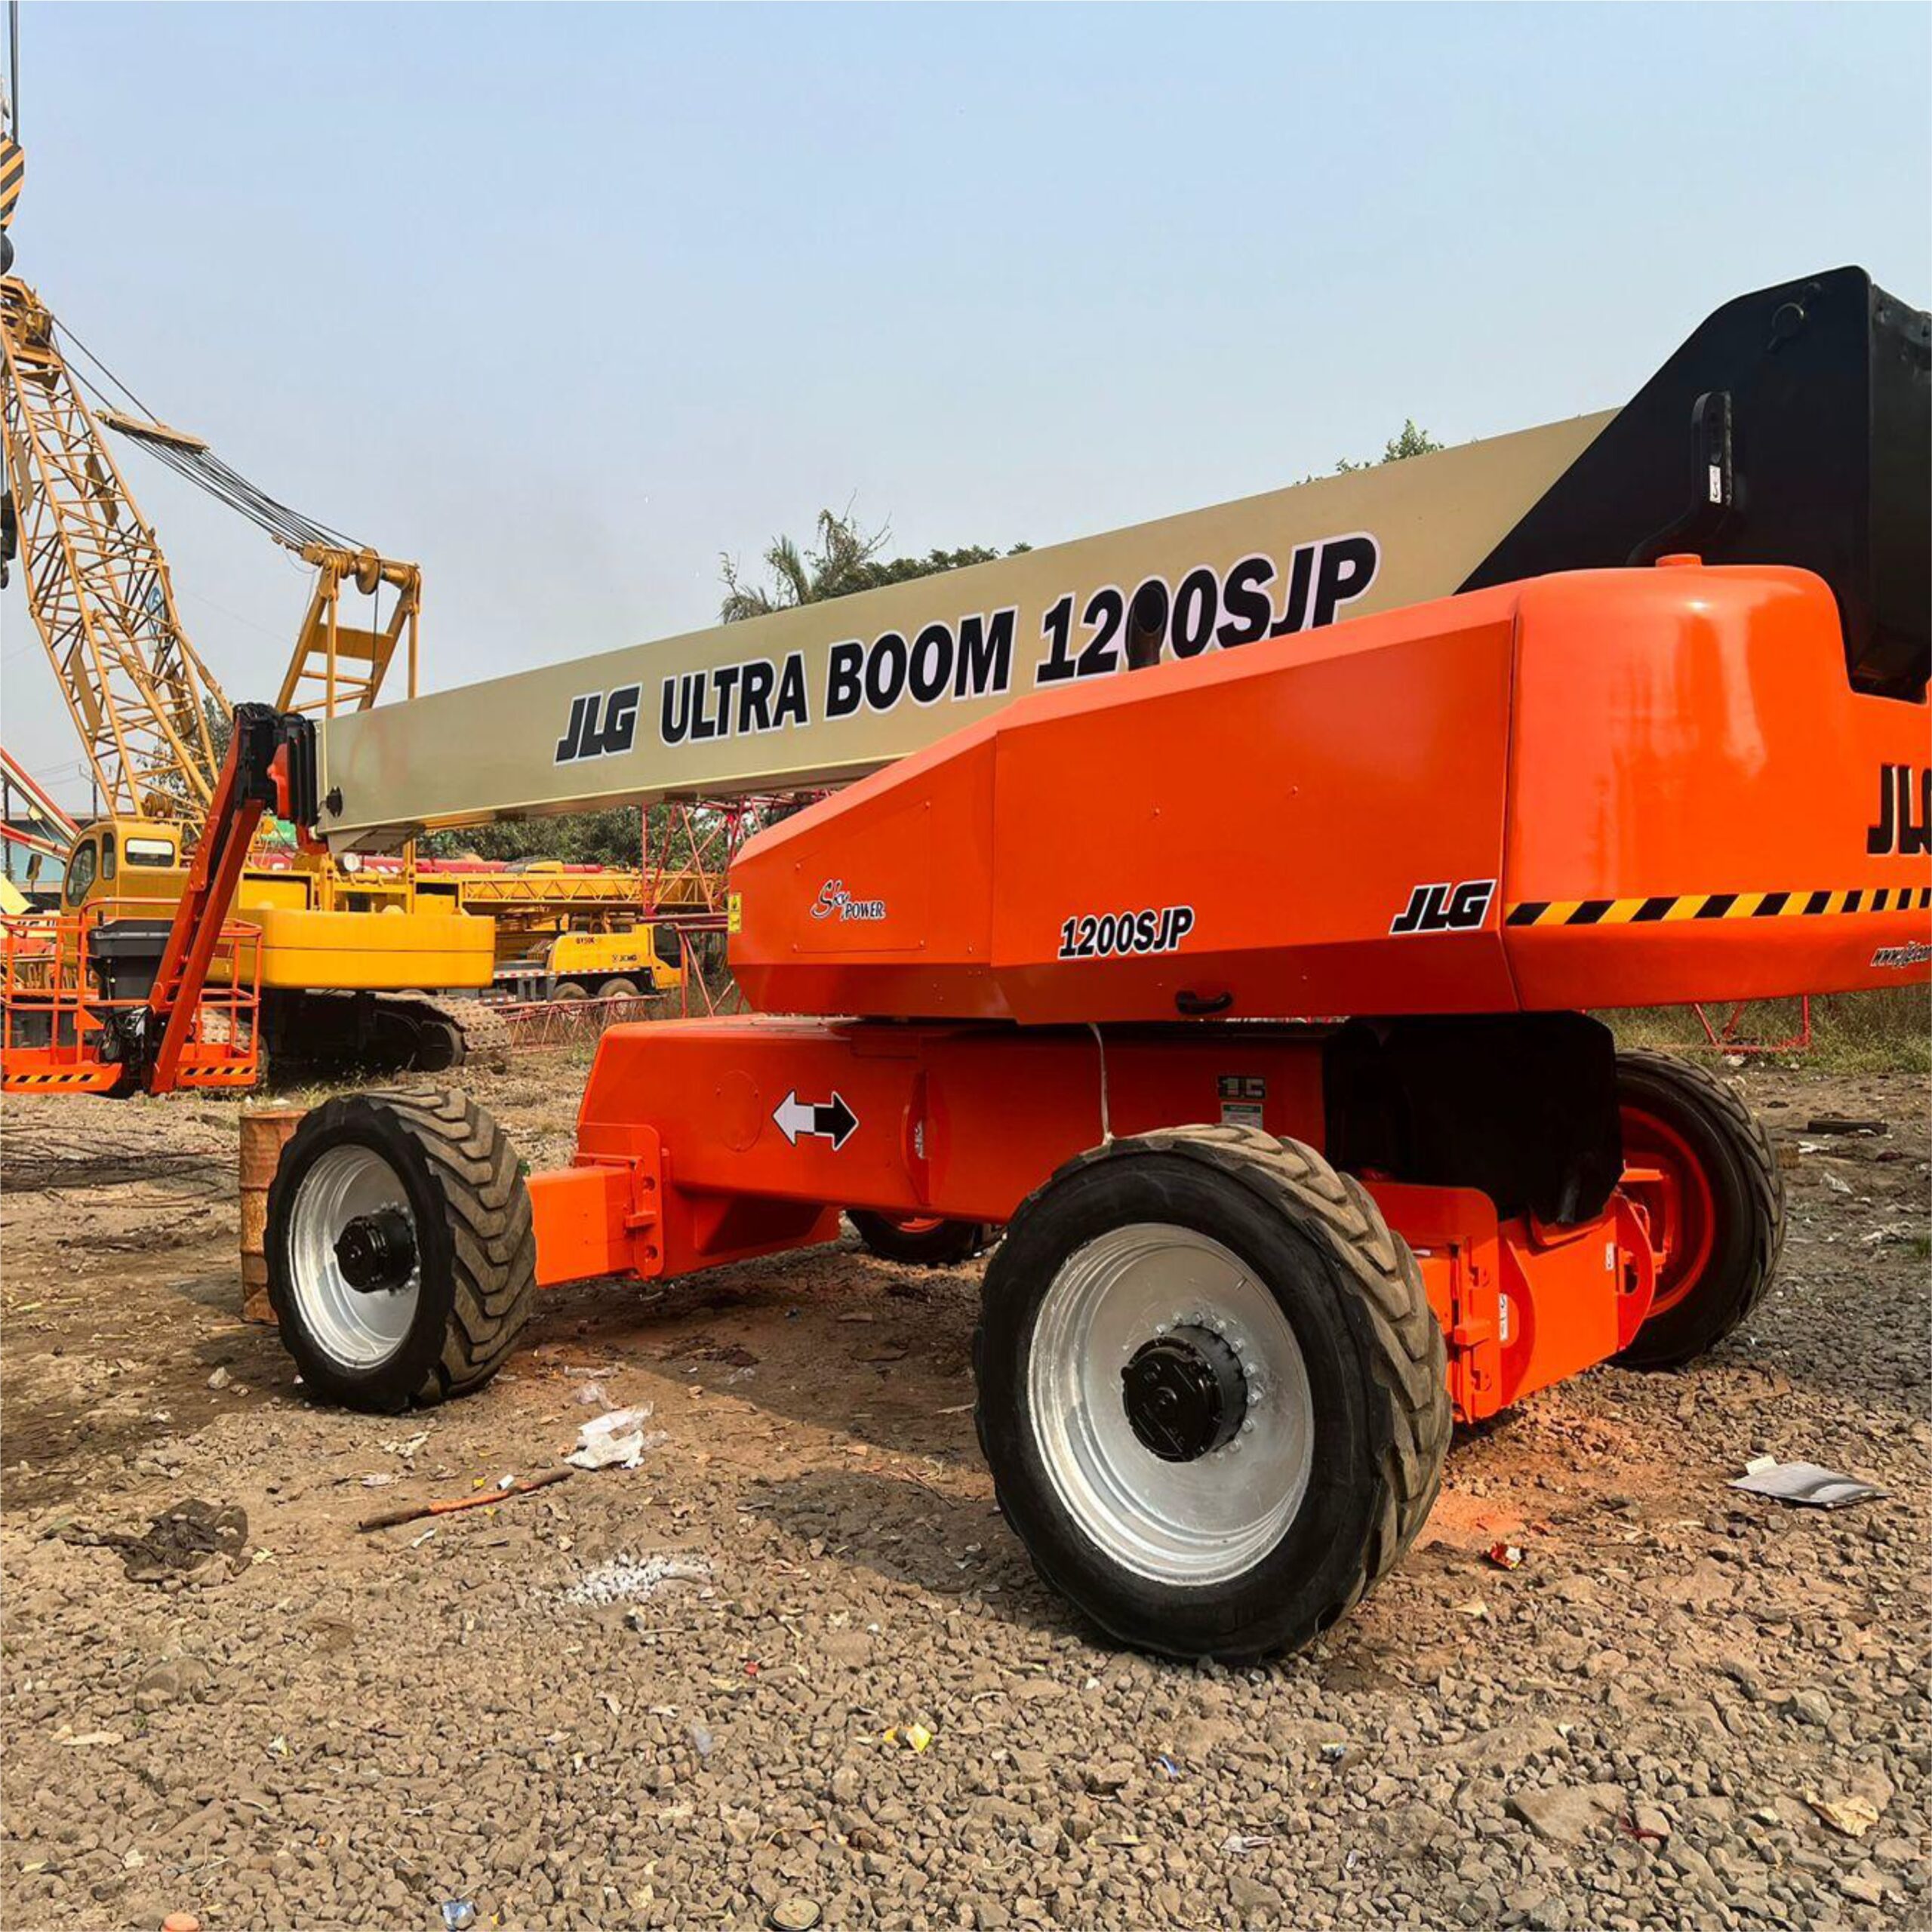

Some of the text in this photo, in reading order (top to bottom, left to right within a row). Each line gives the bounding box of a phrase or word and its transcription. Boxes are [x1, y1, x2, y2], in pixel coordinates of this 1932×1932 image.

[555, 685, 641, 764] JLG
[660, 654, 809, 745] ULTRA
[825, 606, 1017, 720] BOOM
[844, 900, 886, 920] POWER
[1057, 906, 1195, 959] 1200SJP
[1389, 880, 1497, 934] JLG
